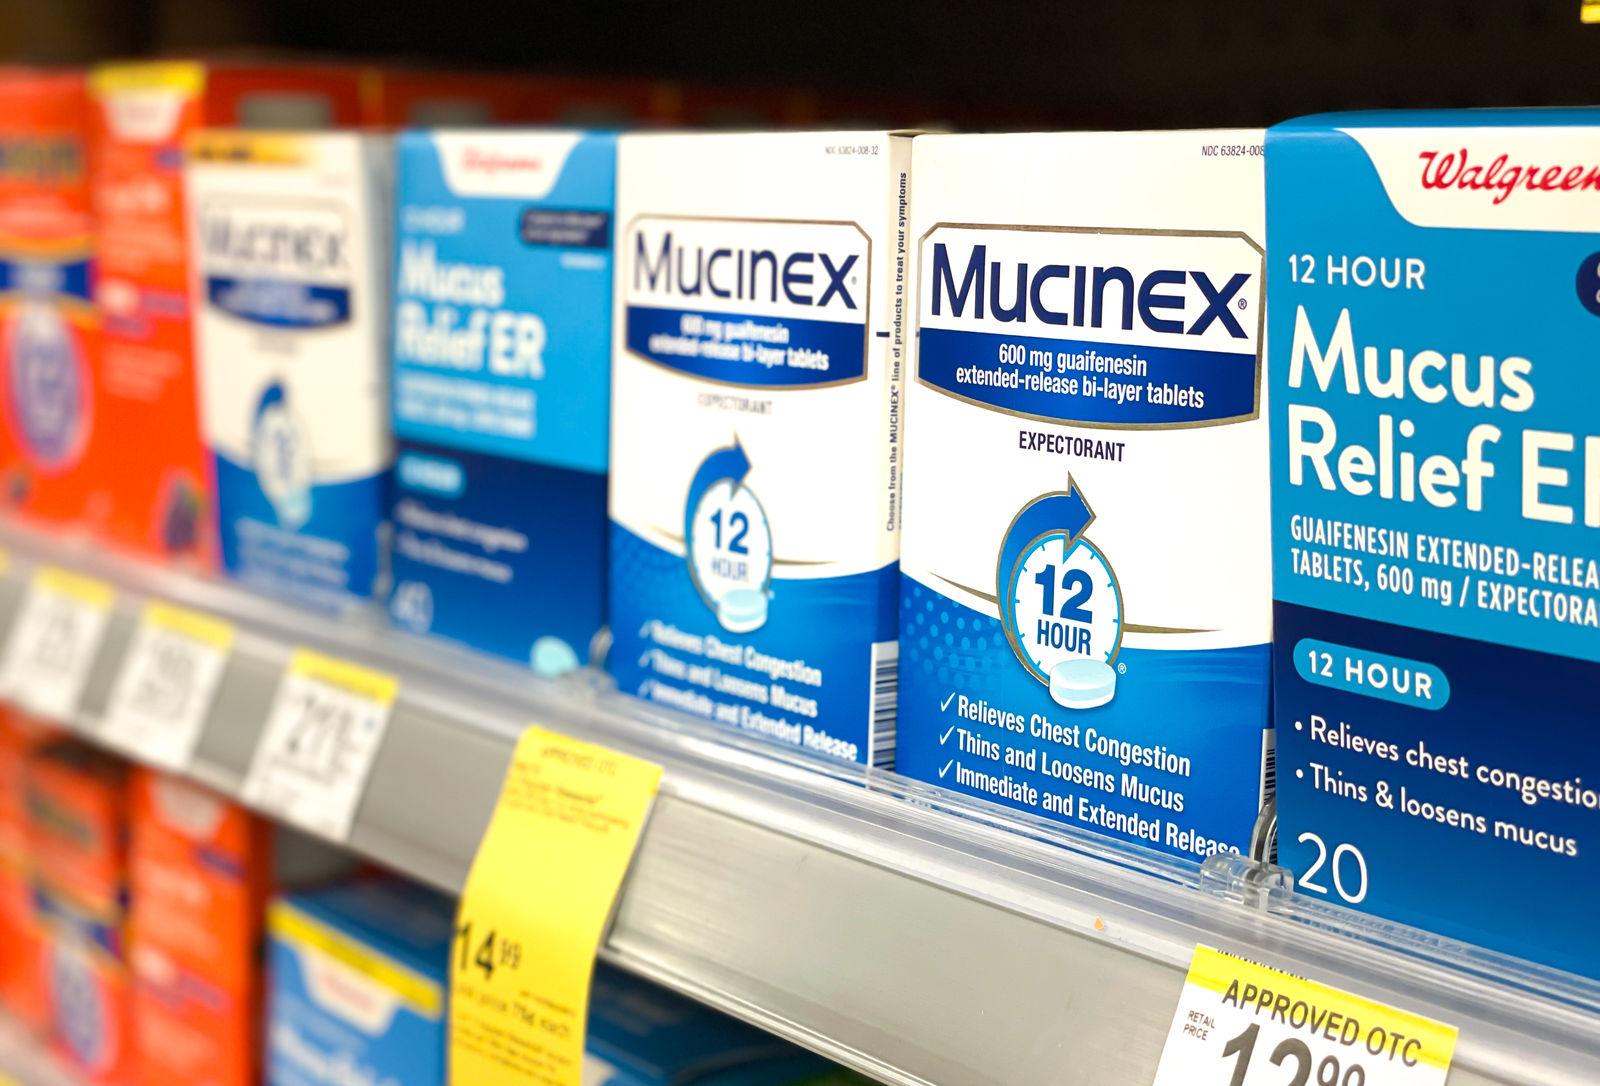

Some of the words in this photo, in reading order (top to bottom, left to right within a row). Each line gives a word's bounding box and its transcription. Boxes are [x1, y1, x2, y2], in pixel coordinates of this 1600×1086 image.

[1201, 145, 1219, 157] NDC
[899, 172, 907, 227] symptoms
[898, 230, 906, 254] your
[896, 257, 904, 282] treat
[896, 284, 902, 295] to
[1289, 254, 1316, 284] 12
[1327, 255, 1425, 290] HOUR
[893, 299, 902, 345] products
[787, 347, 829, 371] tablets
[891, 361, 900, 381] line
[893, 348, 900, 358] of
[999, 343, 1026, 365] 600
[1029, 349, 1053, 372] mg
[1057, 350, 1147, 377] guaifenesin
[1288, 304, 1535, 412] Mucus
[956, 365, 1078, 395] extended-release
[1082, 376, 1142, 404] bi-layer
[1146, 382, 1204, 409] tablets
[1019, 430, 1126, 462] EXPECTORANT
[1288, 404, 1501, 512] Relief
[888, 465, 896, 490] from
[710, 508, 749, 555] 12
[887, 493, 895, 532] Choose
[1290, 514, 1409, 559] GUAIFENESIN
[1035, 564, 1094, 625] 12
[1291, 548, 1370, 592] TABLETS,
[1377, 563, 1414, 595] 600
[1421, 576, 1452, 606] mg
[1036, 619, 1092, 656] HOUR
[1308, 650, 1333, 678] 12
[1345, 657, 1432, 701] HOUR
[803, 724, 858, 762] Release
[958, 695, 1025, 734] Relieves
[1030, 713, 1080, 748] Chest
[1085, 727, 1191, 777] Congestion
[957, 728, 1000, 761] Thins
[1005, 748, 1036, 772] and
[1041, 752, 1115, 793] Loosens
[1121, 773, 1184, 813] Mucus
[1310, 714, 1399, 762] Relieves
[1405, 741, 1469, 779] chest
[1476, 765, 1600, 809] congestio
[956, 762, 1038, 806] Immediate
[1042, 794, 1073, 818] and
[1078, 798, 1160, 844] Extended
[1310, 762, 1368, 802] Thins
[1375, 780, 1394, 810] &
[1401, 786, 1487, 833] loosens
[1494, 820, 1578, 857] mucus
[1298, 832, 1368, 904] 20
[457, 922, 496, 981] 14
[1182, 1023, 1209, 1041] PRICE
[1188, 1010, 1216, 1030] RETAIL
[1221, 979, 1360, 1047] APPROVED
[1365, 1026, 1422, 1067] OTC
